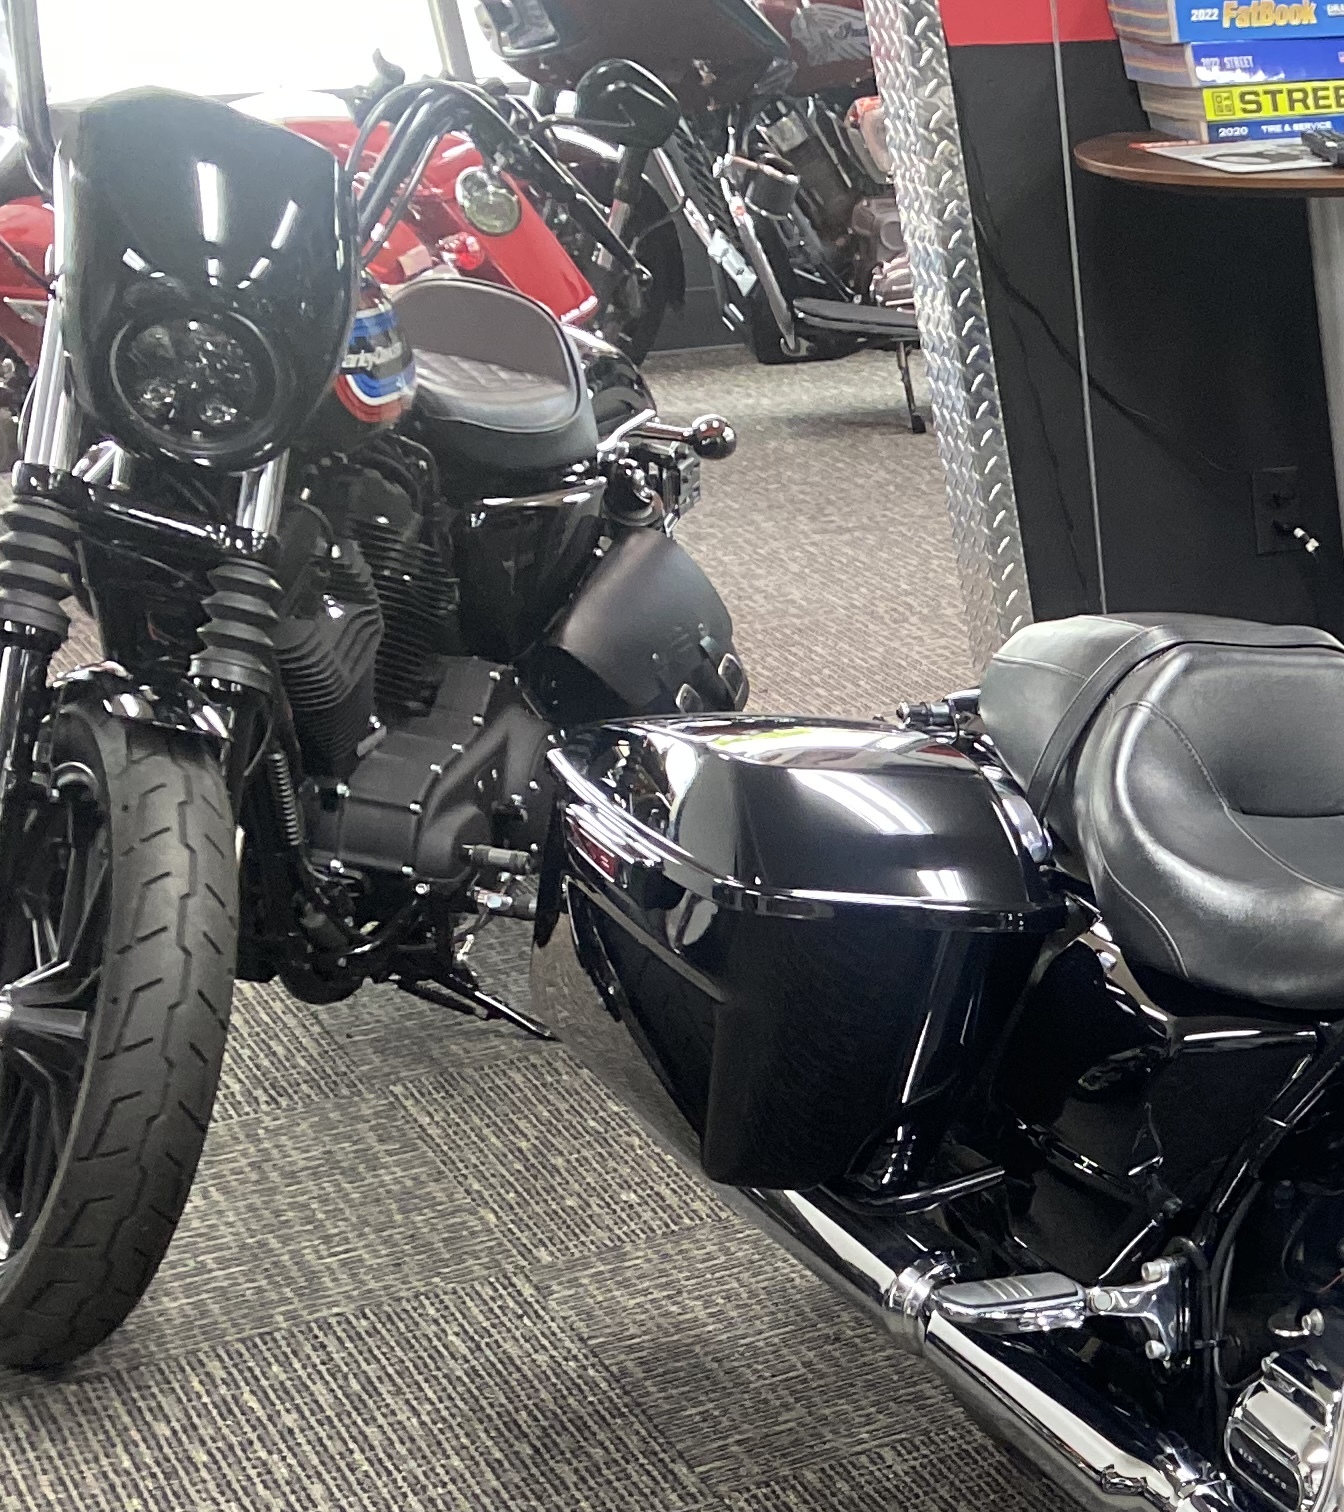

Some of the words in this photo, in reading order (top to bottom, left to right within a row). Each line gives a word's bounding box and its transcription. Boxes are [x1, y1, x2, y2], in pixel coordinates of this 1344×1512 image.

[1190, 8, 1219, 21] 2022
[1222, 0, 1317, 29] FatBook
[1218, 126, 1249, 138] 2020
[1261, 124, 1282, 134] TIRE
[1284, 123, 1291, 132] &
[1292, 121, 1332, 133] SERVICE
